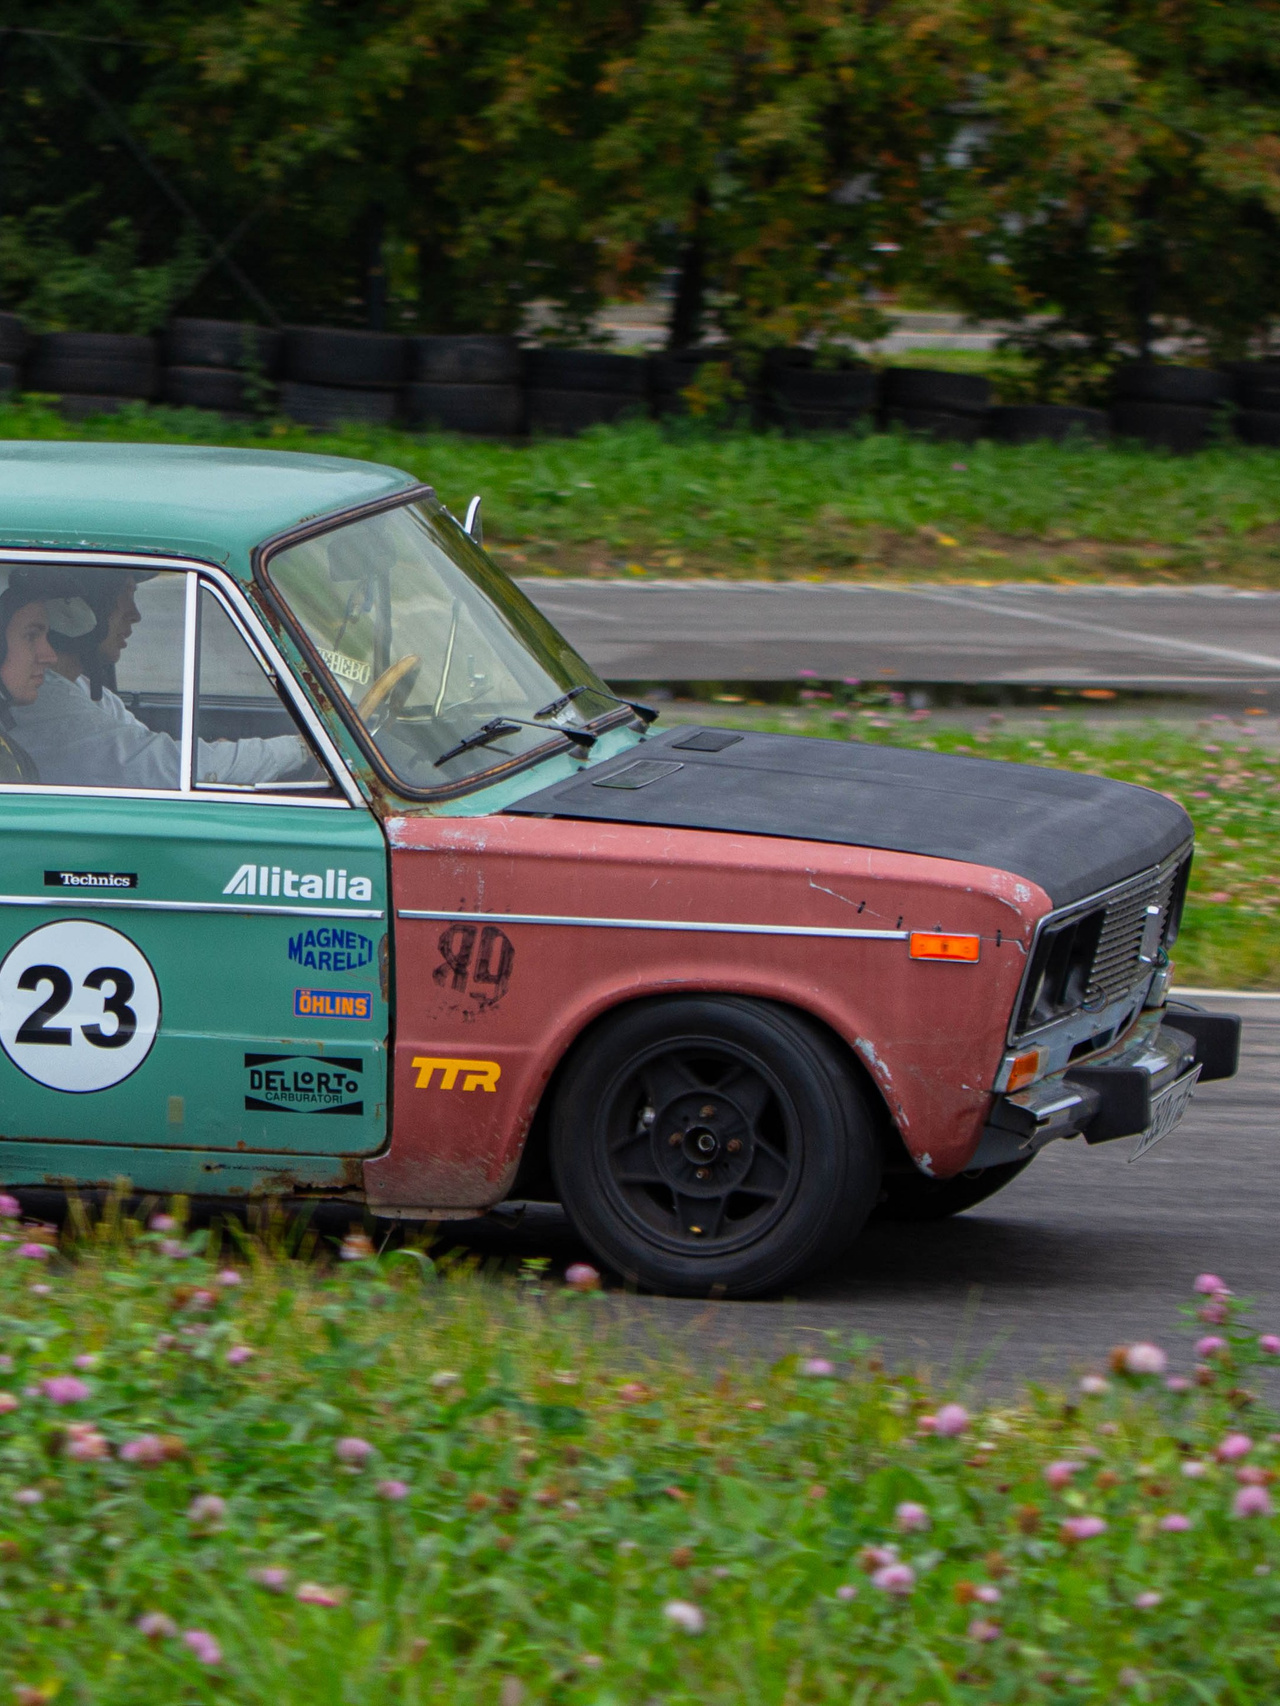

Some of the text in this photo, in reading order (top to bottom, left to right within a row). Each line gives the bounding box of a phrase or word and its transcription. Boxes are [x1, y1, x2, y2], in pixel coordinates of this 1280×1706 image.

[61, 873, 130, 887] Technics
[222, 864, 372, 901] Alitalia
[288, 928, 373, 956] MAGNETI
[288, 946, 373, 971] MARELLI
[15, 964, 138, 1049] 23
[299, 990, 367, 1016] ÖHLINS
[411, 1056, 501, 1092] TTR
[265, 1091, 343, 1105] CARBURATORI
